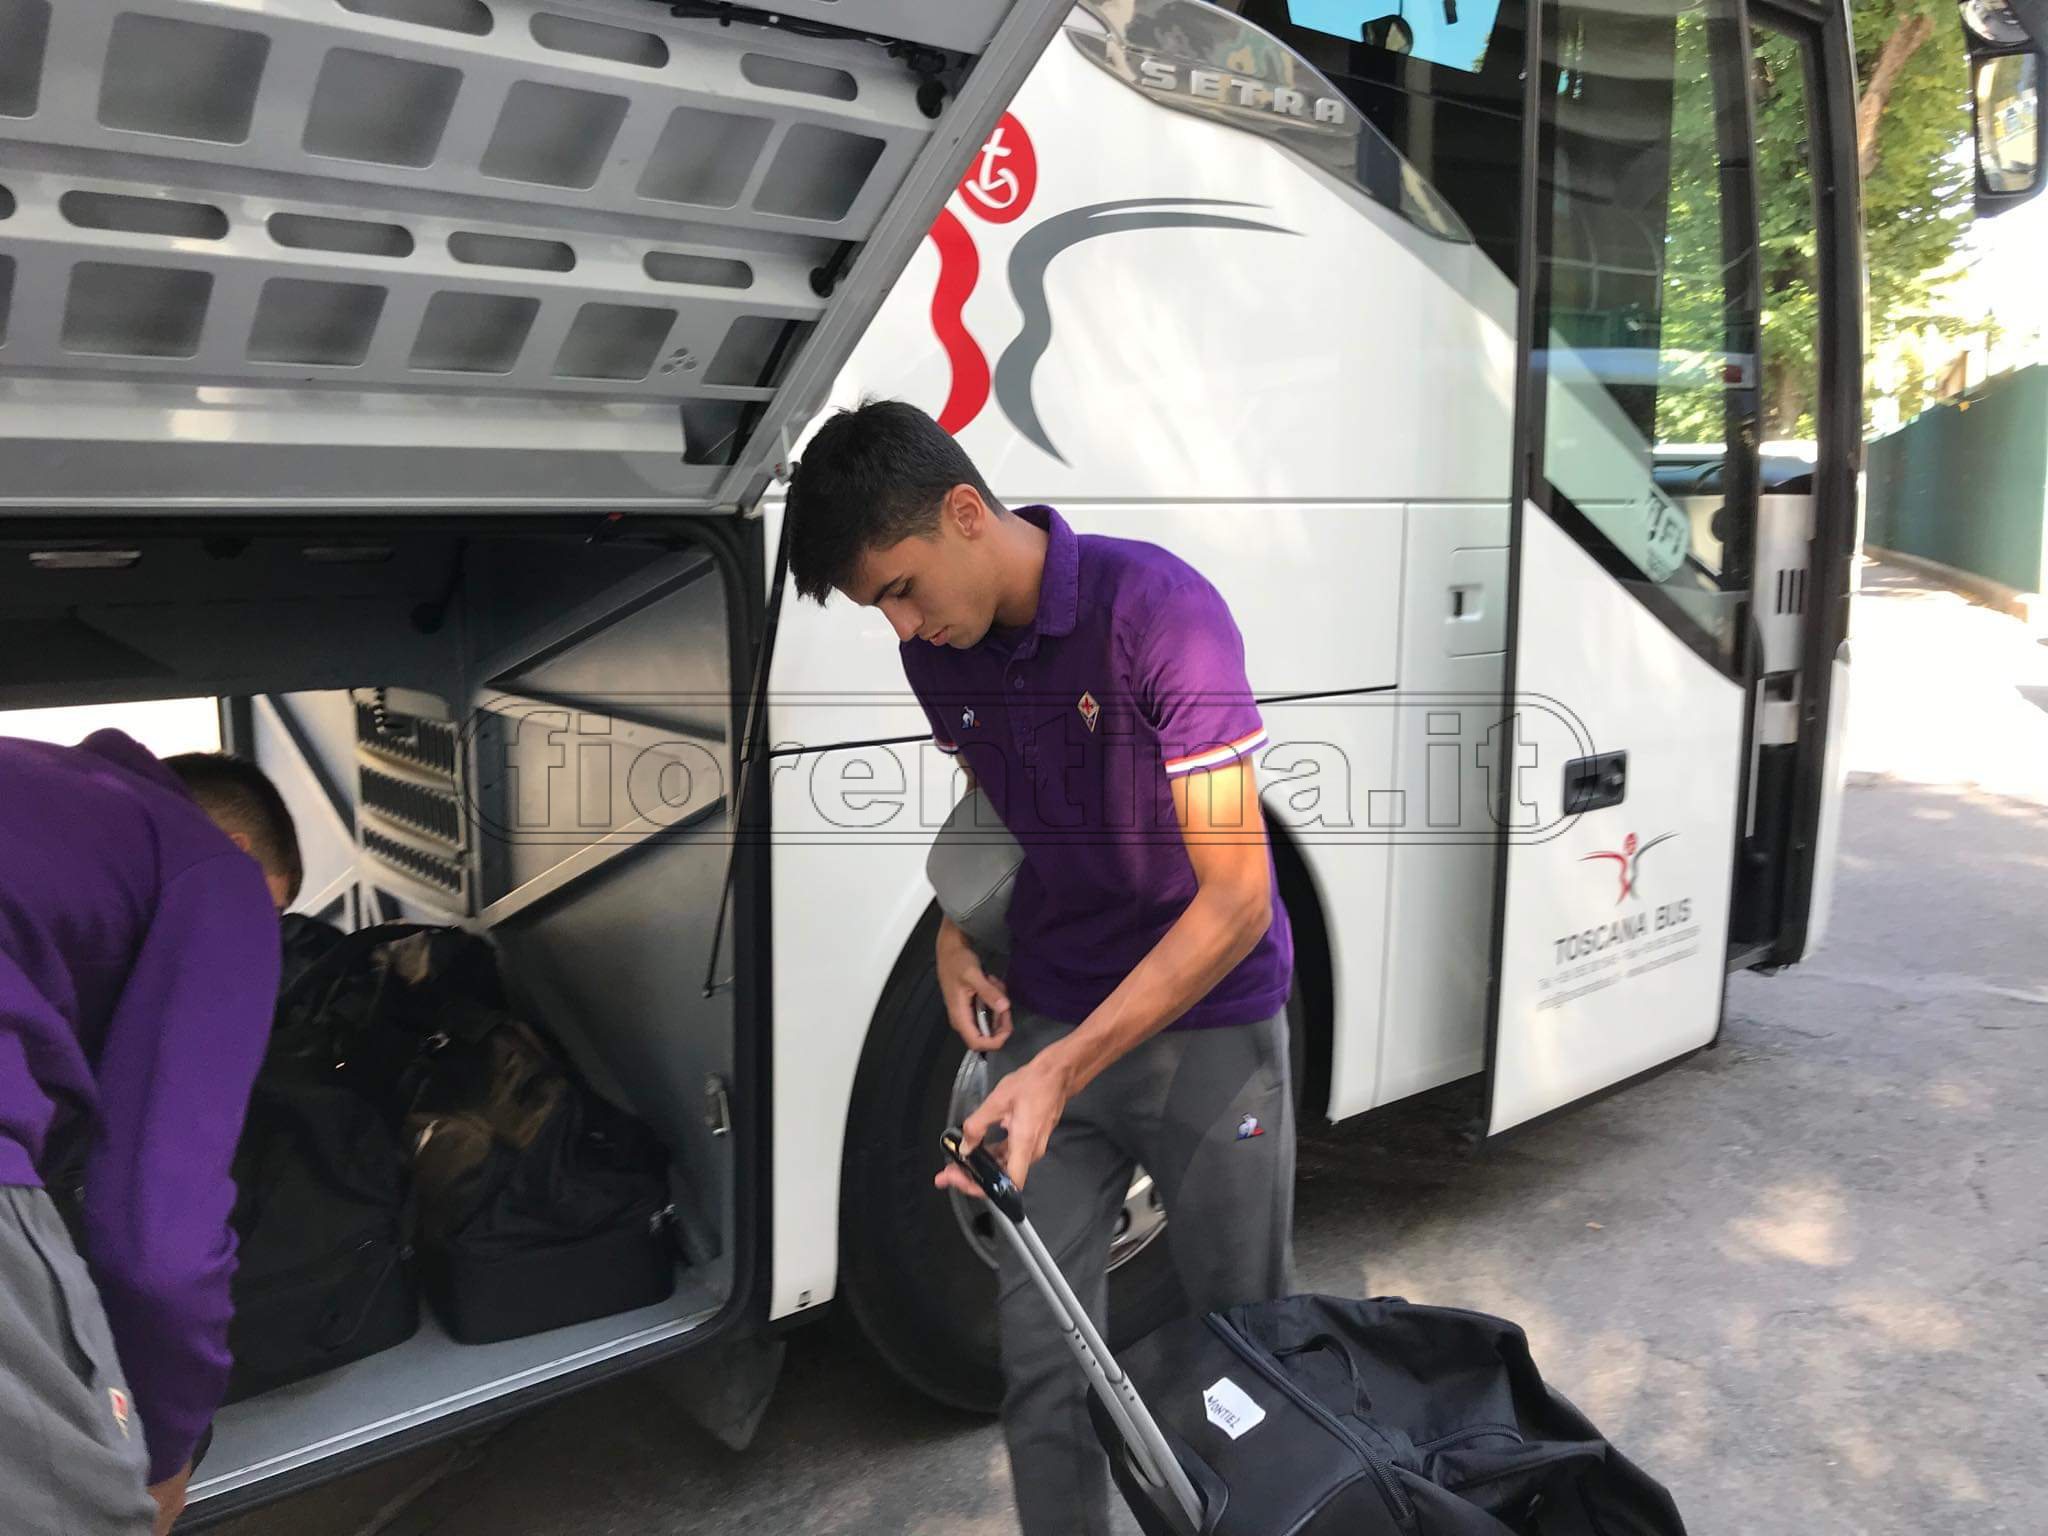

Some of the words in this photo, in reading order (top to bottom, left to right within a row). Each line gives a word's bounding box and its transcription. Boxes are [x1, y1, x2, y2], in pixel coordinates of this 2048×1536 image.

[1140, 61, 1345, 125] SETRA
[1554, 911, 1648, 966] TOSCANA
[1655, 898, 1692, 932] BUS
